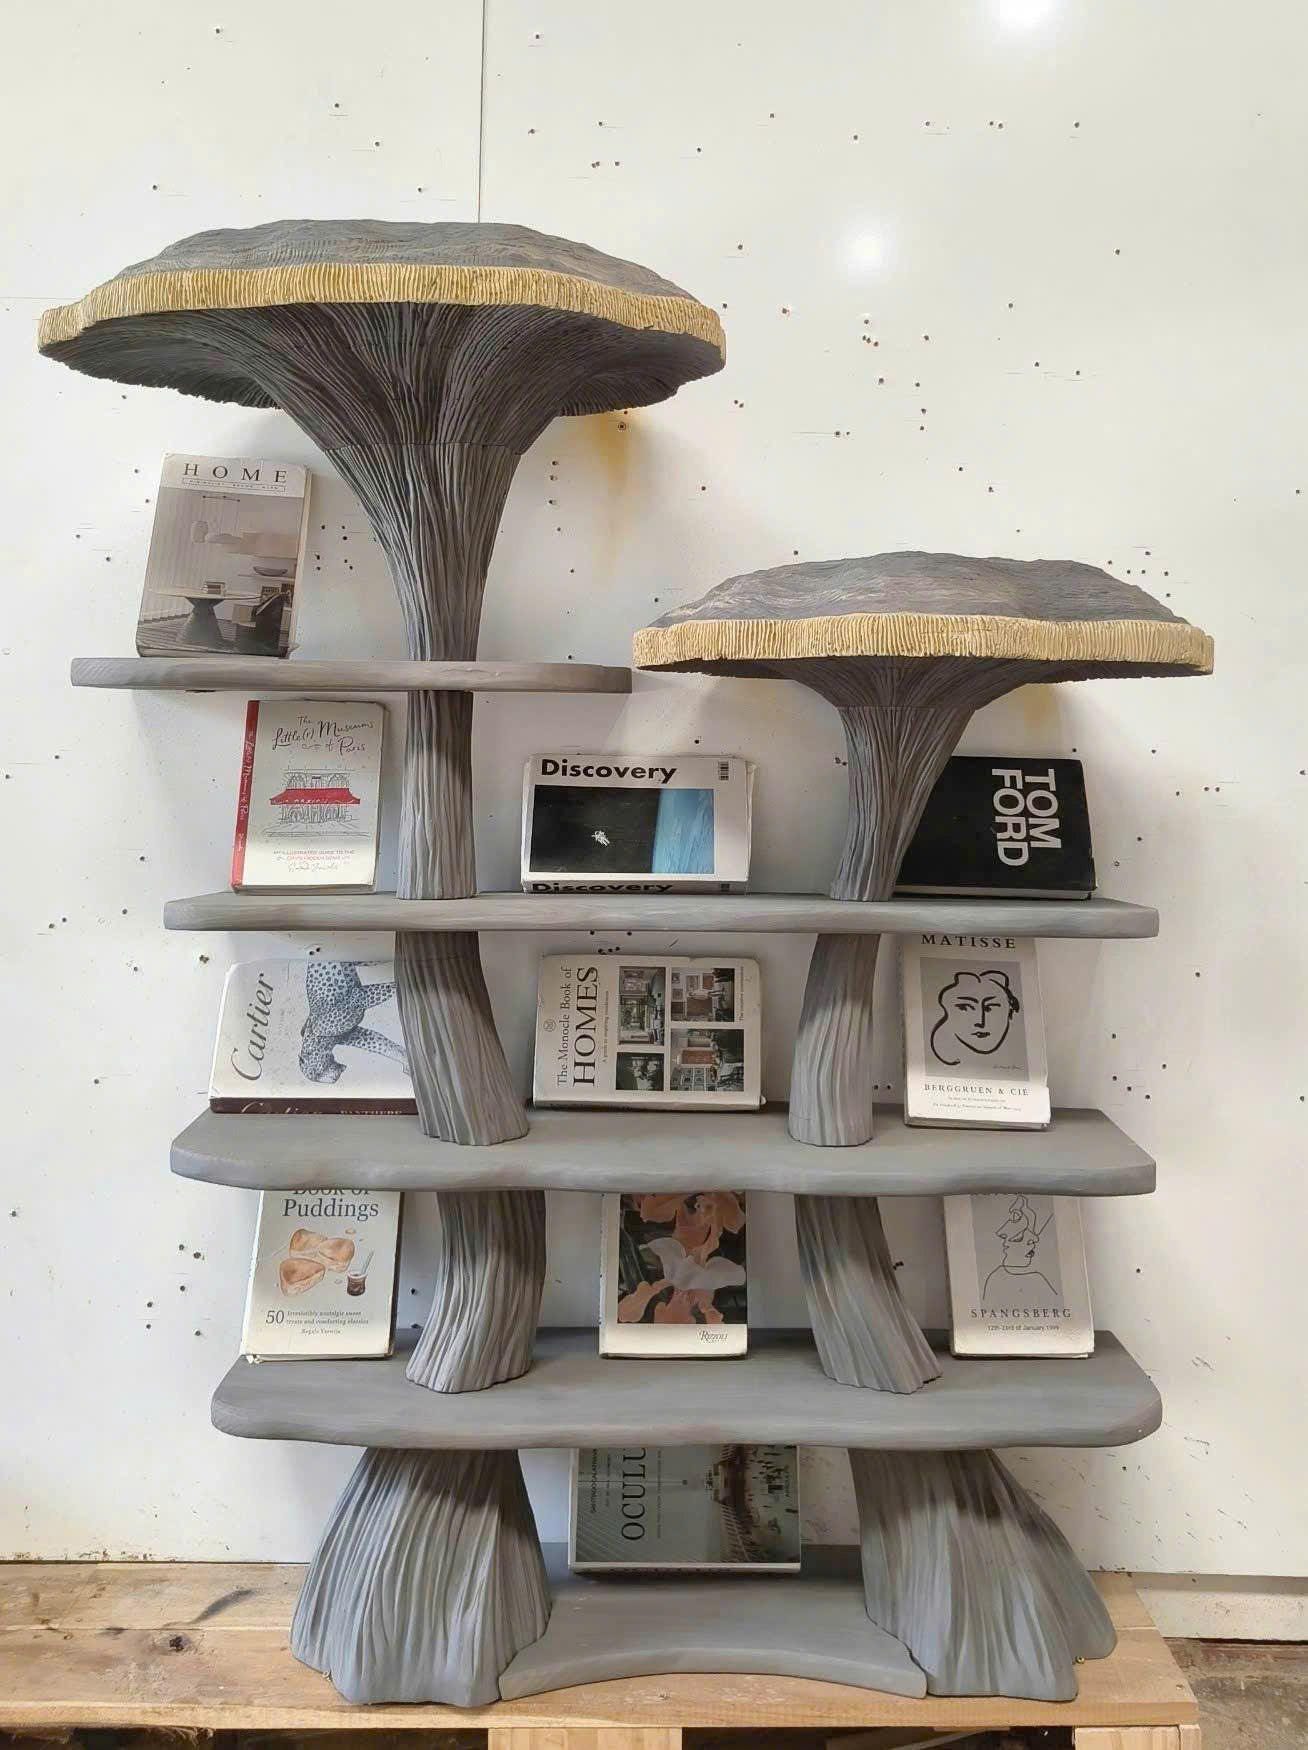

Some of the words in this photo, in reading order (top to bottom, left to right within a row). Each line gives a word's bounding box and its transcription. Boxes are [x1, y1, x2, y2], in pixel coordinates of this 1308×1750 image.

[183, 463, 287, 483] HOME
[296, 715, 312, 726] The
[338, 736, 366, 756] Paris
[541, 758, 677, 784] Discovery
[991, 768, 1030, 866] FORD
[1024, 768, 1062, 849] TOM
[532, 882, 673, 893] Discovery
[921, 934, 1016, 949] MATISSE
[560, 965, 572, 978] of
[560, 983, 572, 1010] Book
[231, 972, 274, 1080] Cartier
[572, 966, 599, 1087] HOMES
[558, 1014, 570, 1062] Monocle
[557, 1063, 569, 1087] The
[924, 1084, 992, 1094] BERGGRUEN
[282, 1197, 379, 1221] Puddings
[266, 1310, 285, 1324] 50
[970, 1308, 1071, 1318] SPANGSBERG
